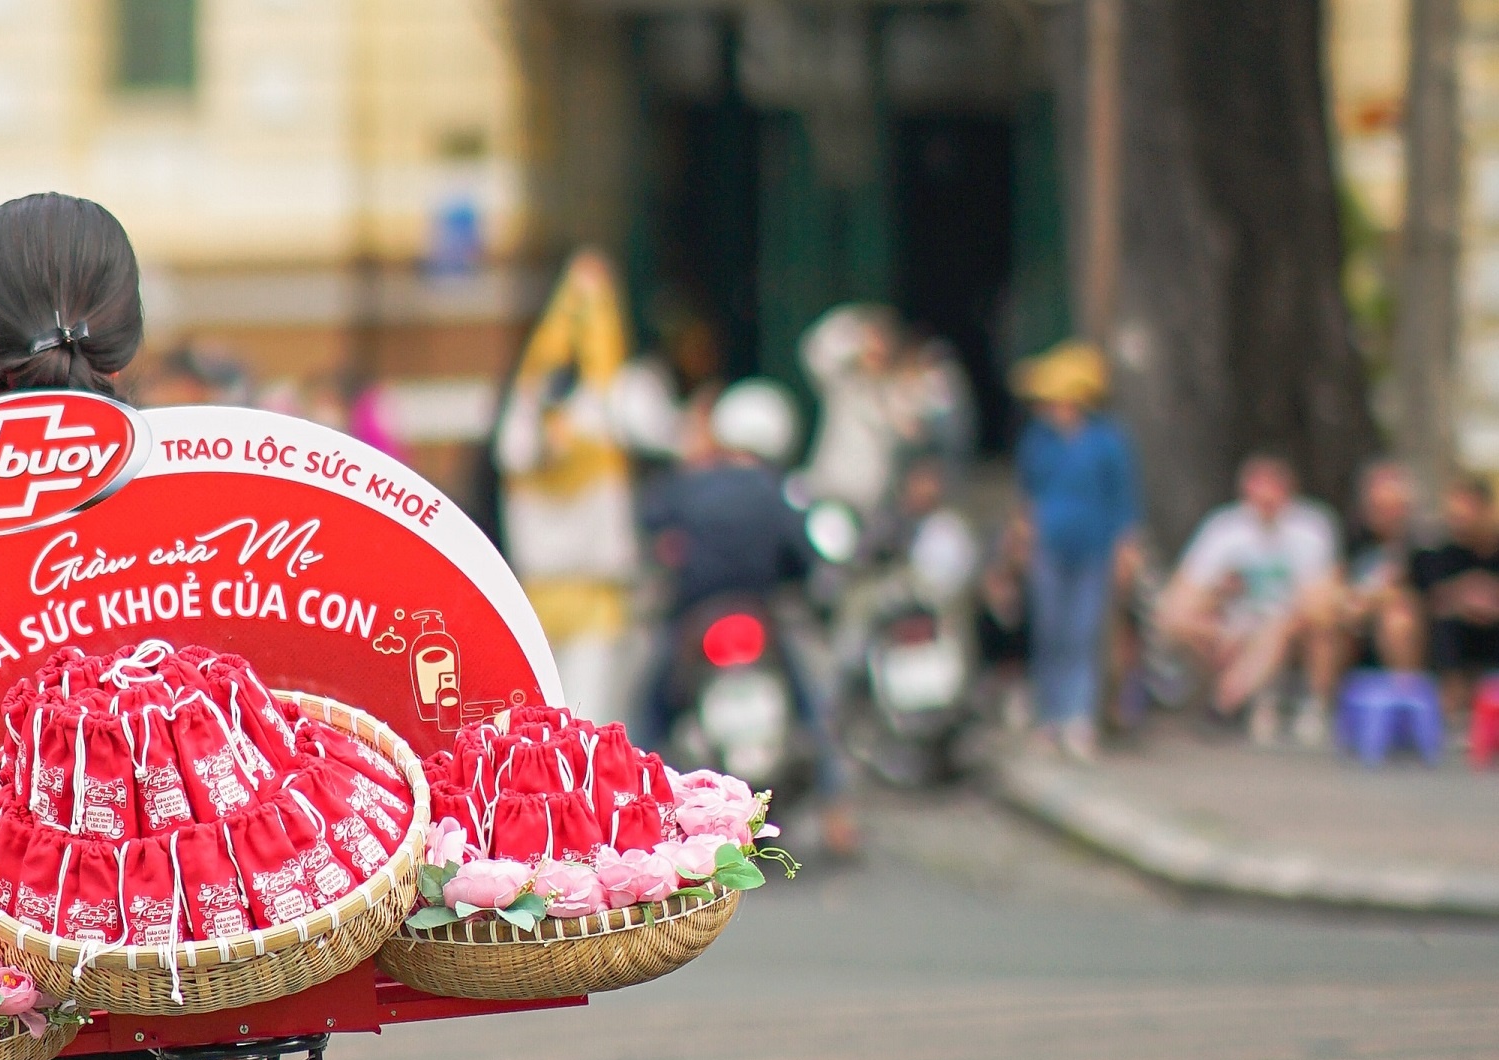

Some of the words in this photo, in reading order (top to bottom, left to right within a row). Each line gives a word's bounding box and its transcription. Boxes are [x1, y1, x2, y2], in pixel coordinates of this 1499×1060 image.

[160, 437, 233, 462] TRAO
[244, 436, 297, 470] LỘC
[304, 450, 361, 487] SỨC
[365, 473, 441, 527] KHOẺ
[149, 539, 219, 565] của
[195, 518, 324, 578] Mẹ
[19, 599, 94, 654] SỨC
[98, 572, 201, 630] KHOẺ
[211, 571, 288, 621] CỦA
[298, 588, 378, 640] CON
